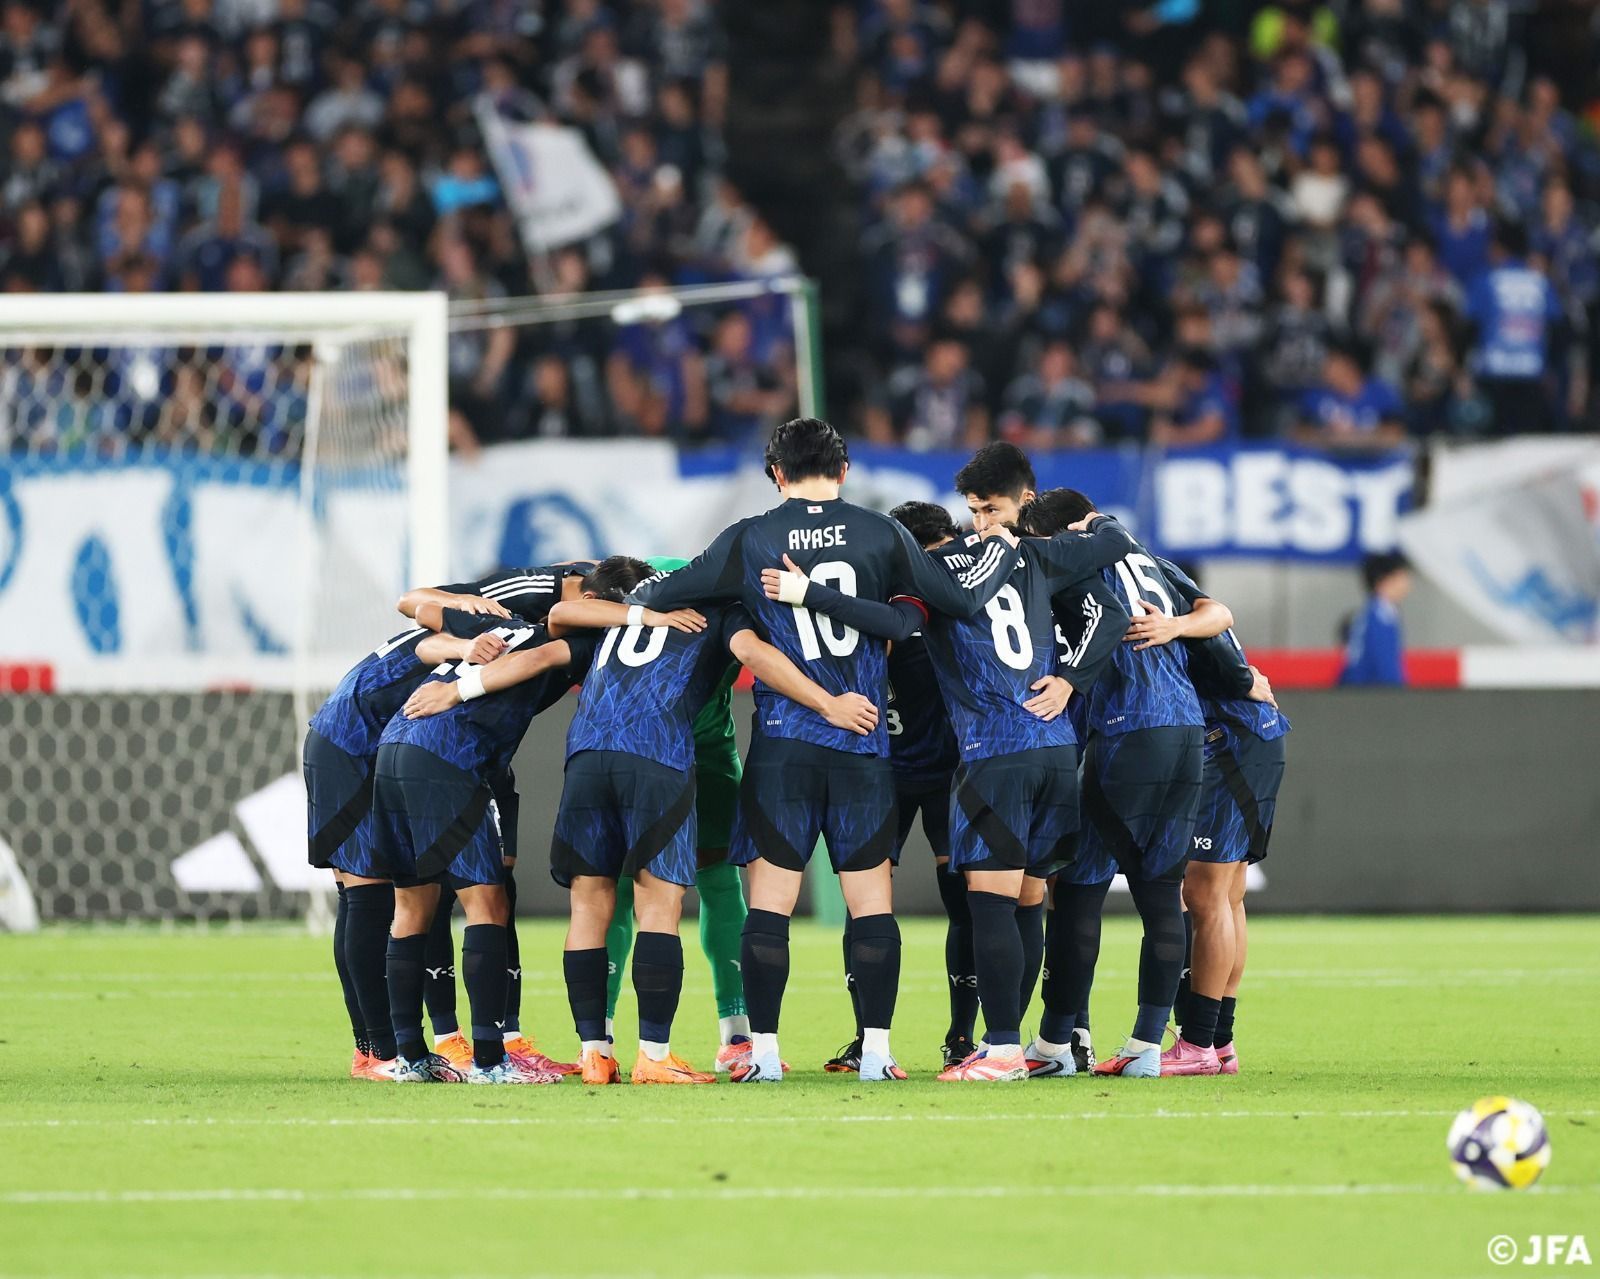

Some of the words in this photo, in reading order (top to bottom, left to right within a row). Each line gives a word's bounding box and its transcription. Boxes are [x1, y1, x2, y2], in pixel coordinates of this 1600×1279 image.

[1155, 450, 1413, 553] BEST
[788, 525, 847, 550] AYASE
[985, 584, 1034, 671] 8
[1193, 836, 1213, 850] Y-3
[950, 974, 978, 988] Y-3
